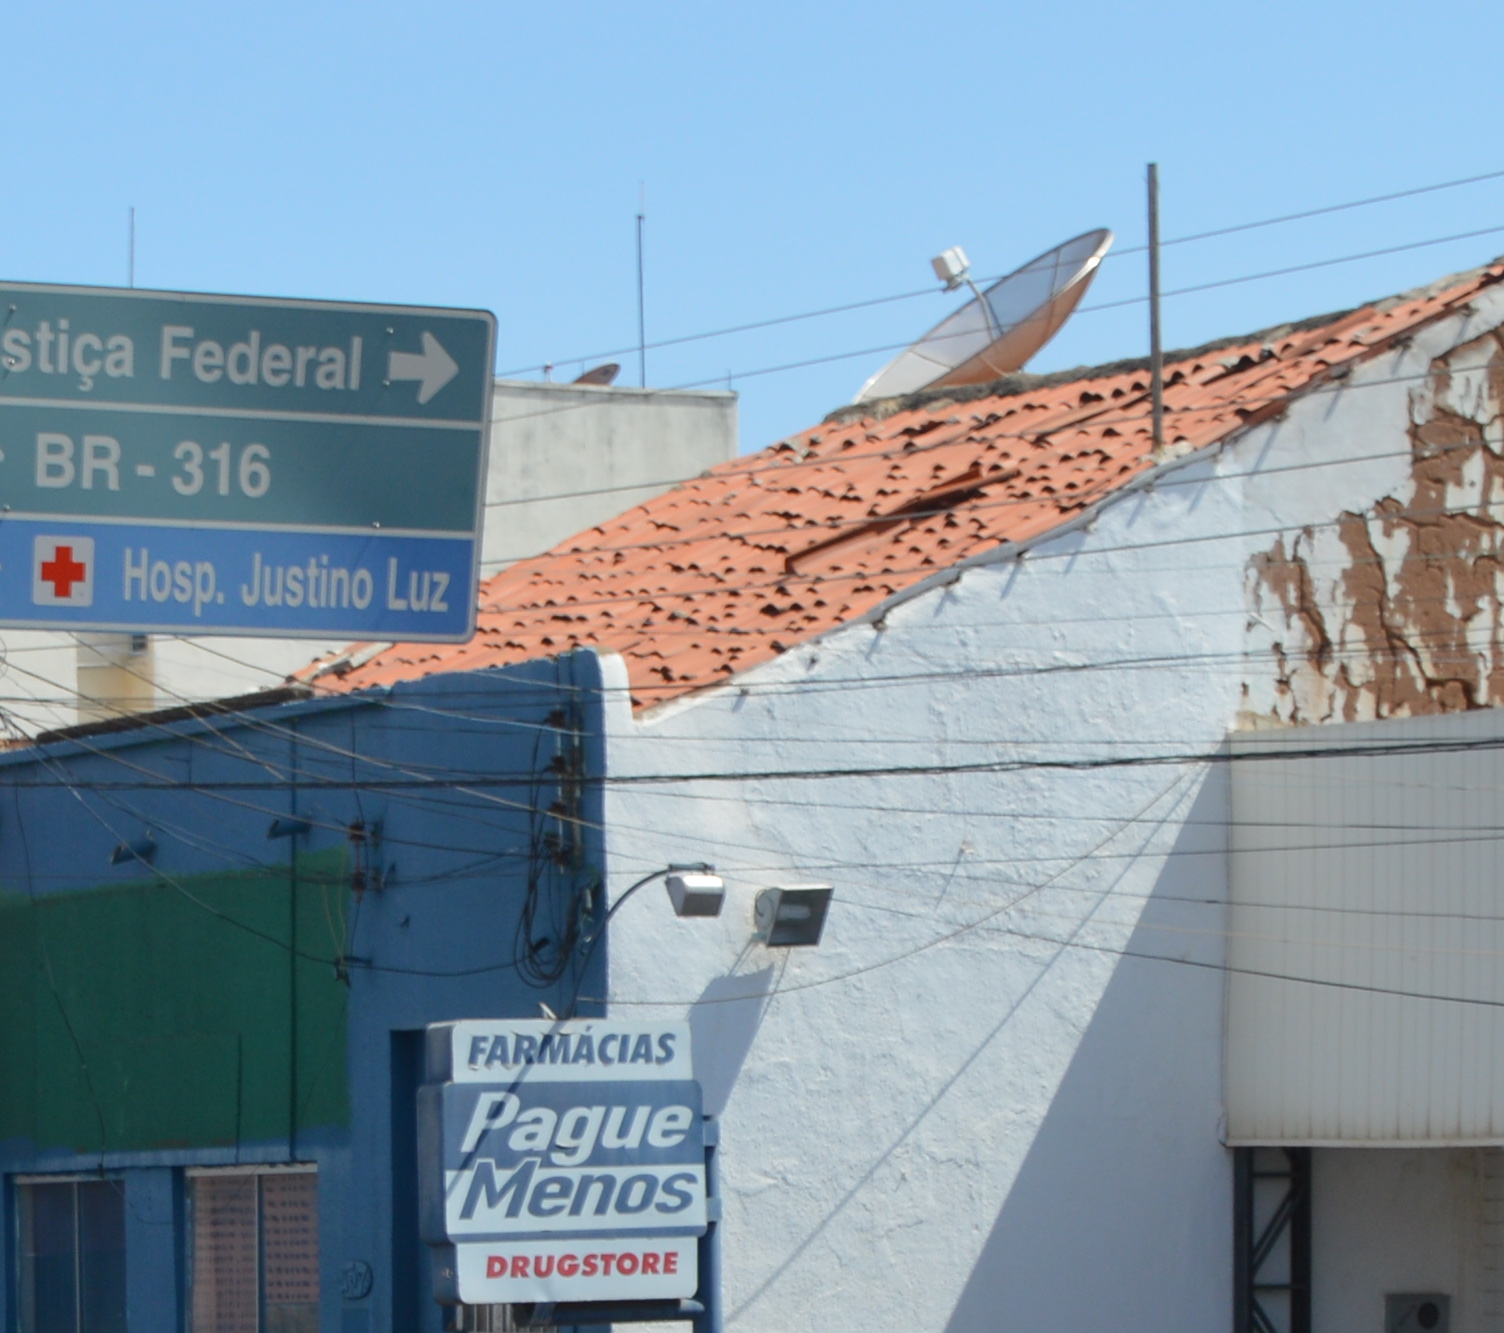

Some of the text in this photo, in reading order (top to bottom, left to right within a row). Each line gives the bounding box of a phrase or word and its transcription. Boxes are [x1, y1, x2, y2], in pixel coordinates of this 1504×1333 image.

[159, 324, 363, 392] Federal
[35, 432, 122, 491] BR
[172, 441, 272, 500] 316
[123, 546, 450, 617] Hosp. Justino Luz
[467, 1025, 677, 1067] FARMÁCIAS
[460, 1091, 694, 1167] Pague
[459, 1158, 699, 1220] Menos
[486, 1252, 679, 1279] DRUGSTORE
